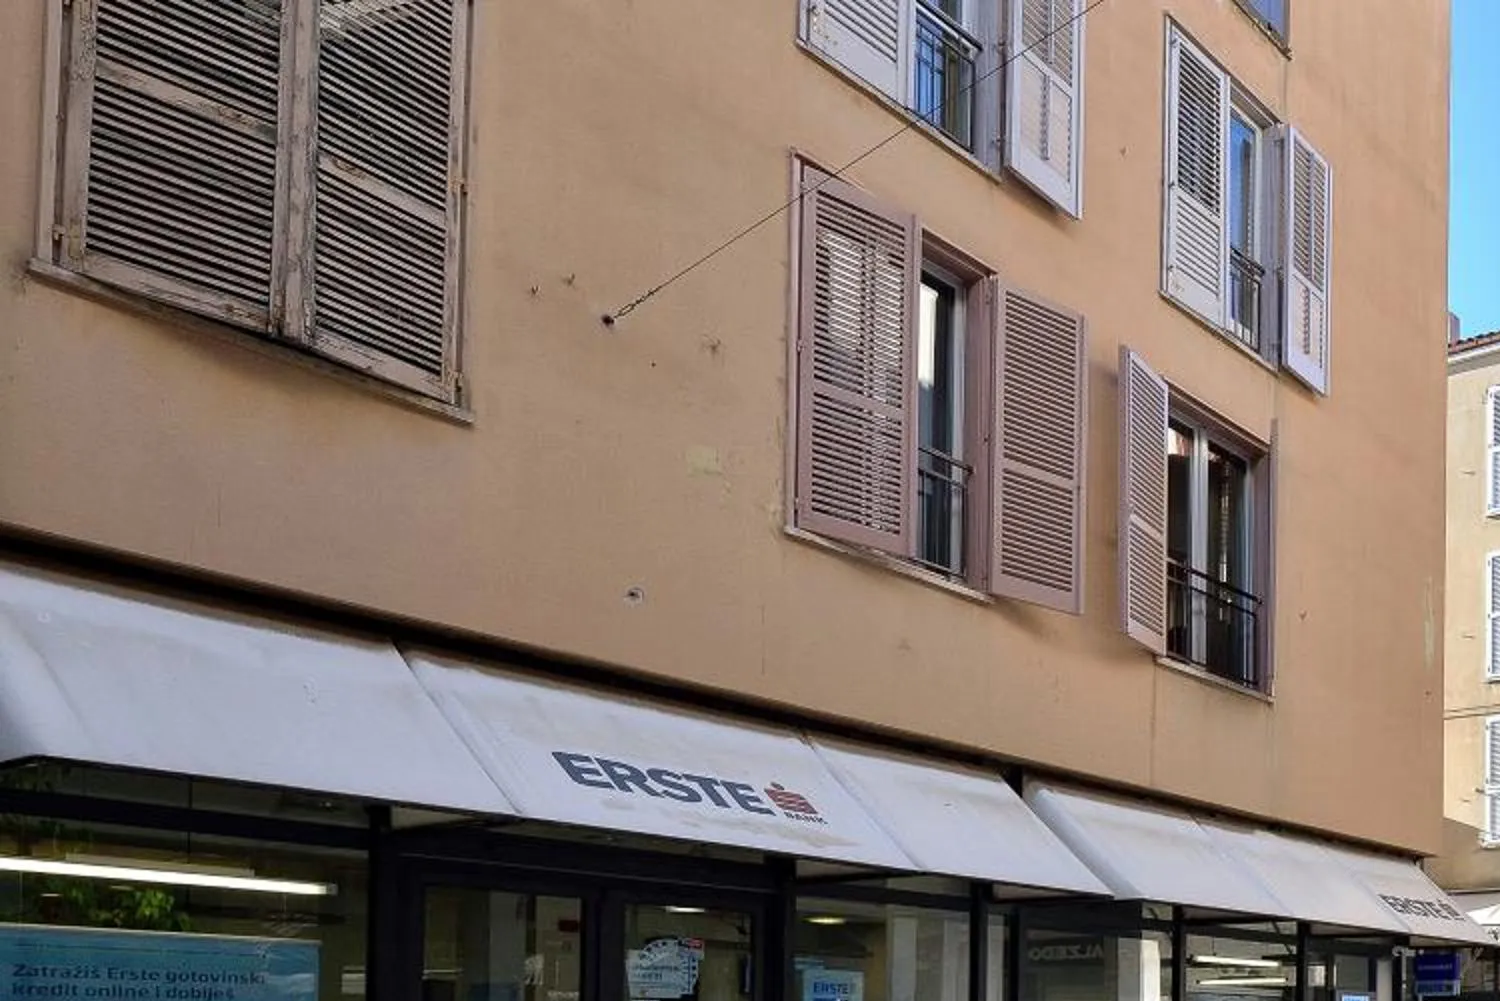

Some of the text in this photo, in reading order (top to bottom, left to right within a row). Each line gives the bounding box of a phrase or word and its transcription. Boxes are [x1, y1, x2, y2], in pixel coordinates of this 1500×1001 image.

[552, 752, 777, 816] ERSTE
[12, 963, 266, 984] Zatražiš Erste gotovinski
[12, 982, 79, 997] kredit
[85, 984, 149, 998] online
[166, 986, 235, 1001] dobiješ
